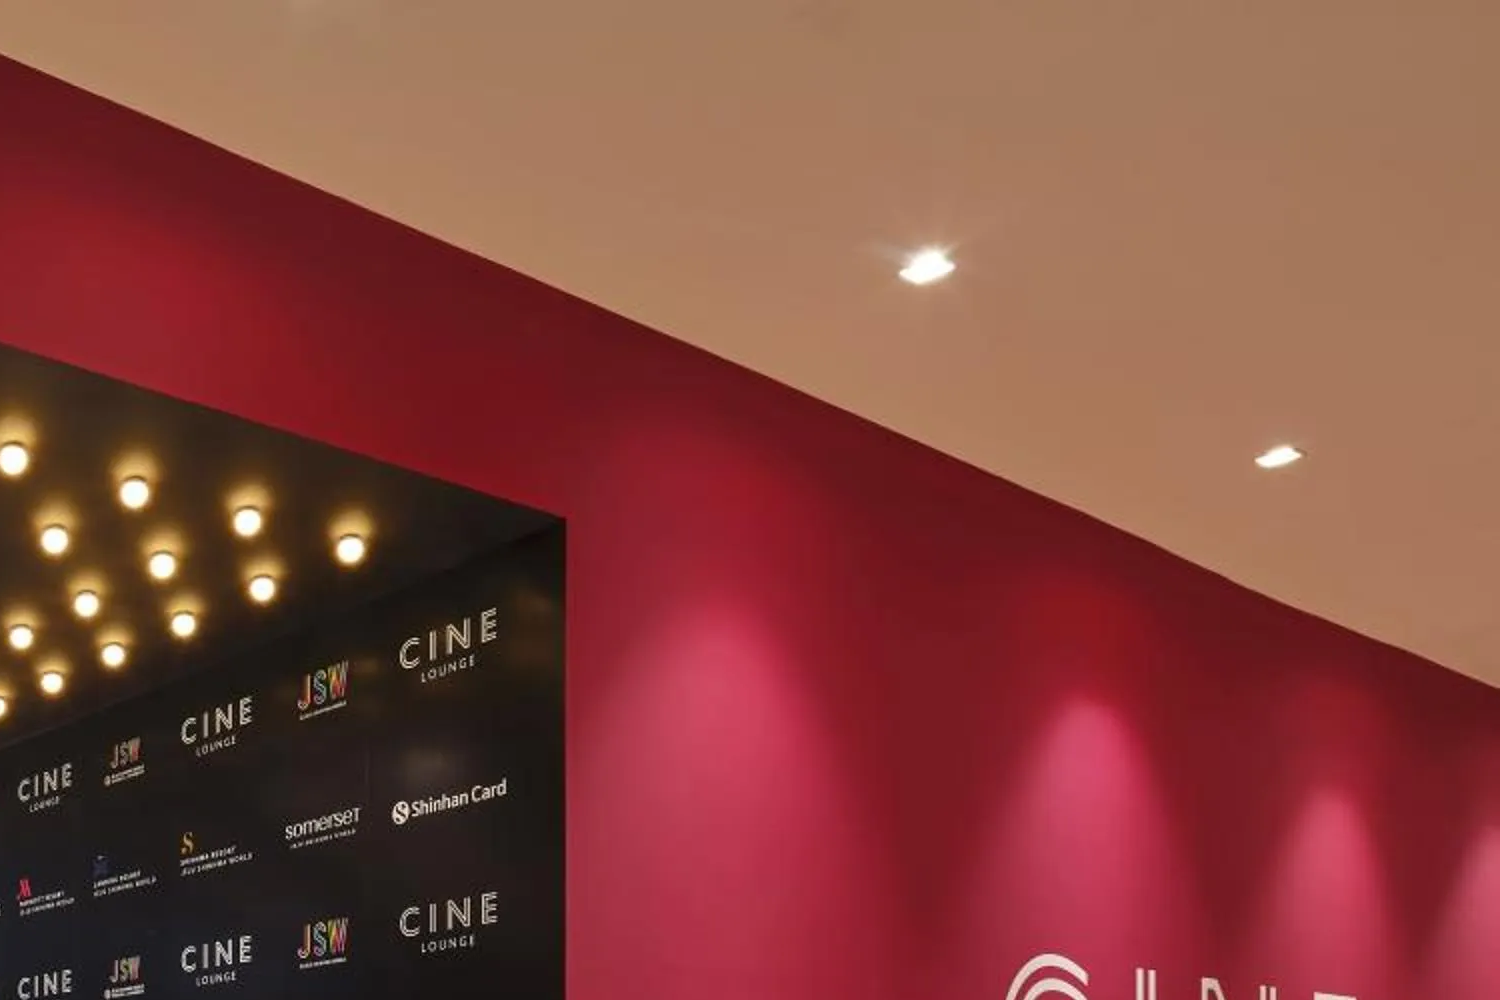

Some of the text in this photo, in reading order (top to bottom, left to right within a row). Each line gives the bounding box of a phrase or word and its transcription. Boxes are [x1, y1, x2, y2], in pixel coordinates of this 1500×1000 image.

[399, 607, 496, 672] CINE
[297, 659, 348, 712] JSW
[421, 654, 474, 683] LOUNGE
[181, 695, 251, 746] CINE
[196, 734, 235, 757] LOUNGE
[17, 761, 71, 803] CINE
[411, 777, 506, 817] Shinhan Card
[399, 890, 498, 938] CINE
[181, 934, 251, 973] CINE
[297, 916, 348, 960] JSW
[421, 934, 473, 954] LOUNGE
[17, 968, 71, 1000] CINE
[195, 970, 236, 987] LOUNGE
